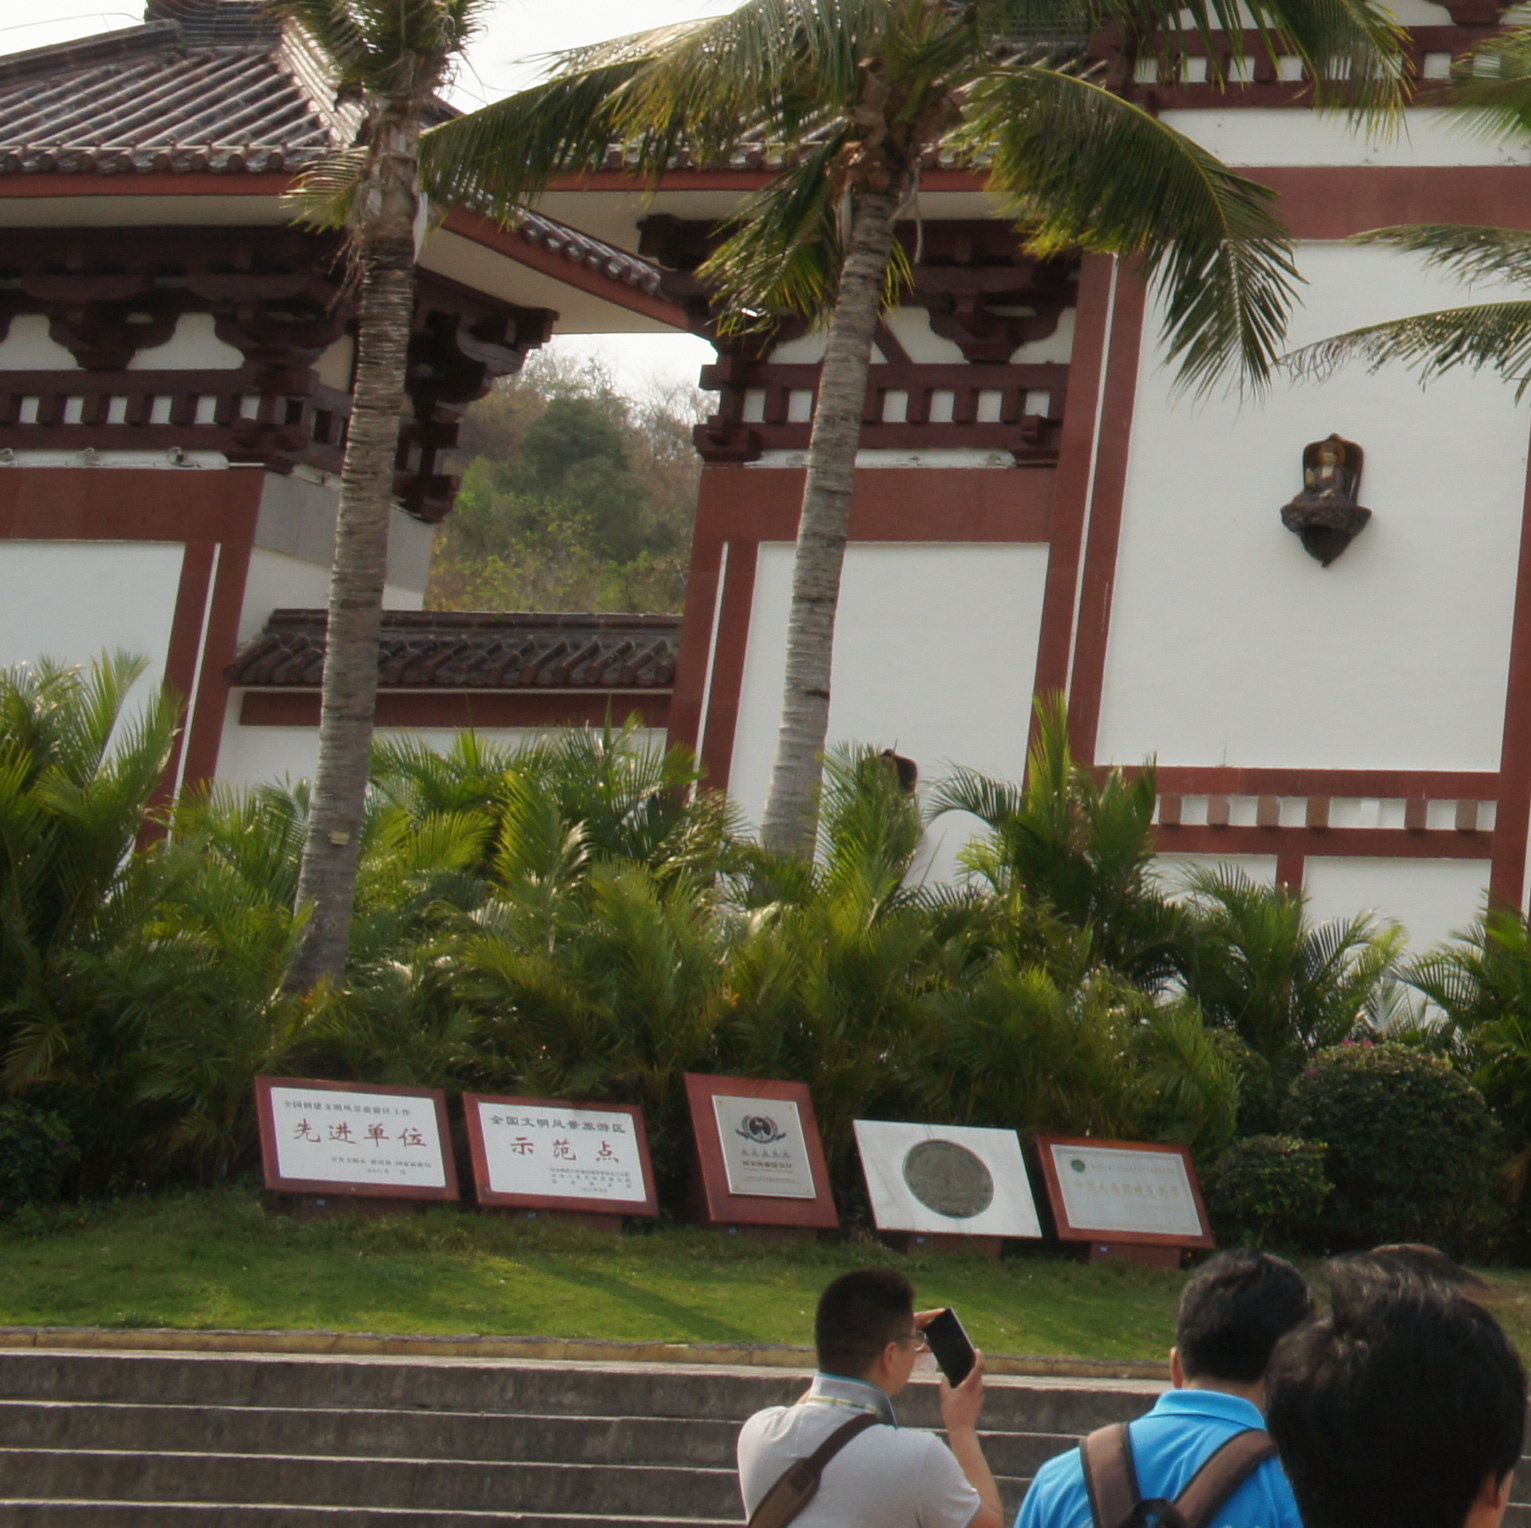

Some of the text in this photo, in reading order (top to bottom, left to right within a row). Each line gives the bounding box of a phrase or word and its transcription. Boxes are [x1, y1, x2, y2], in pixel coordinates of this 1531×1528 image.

[293, 1118, 428, 1148] 先进单位
[490, 1115, 627, 1134] 全国文明风景旅游区
[510, 1136, 620, 1164] 示范点
